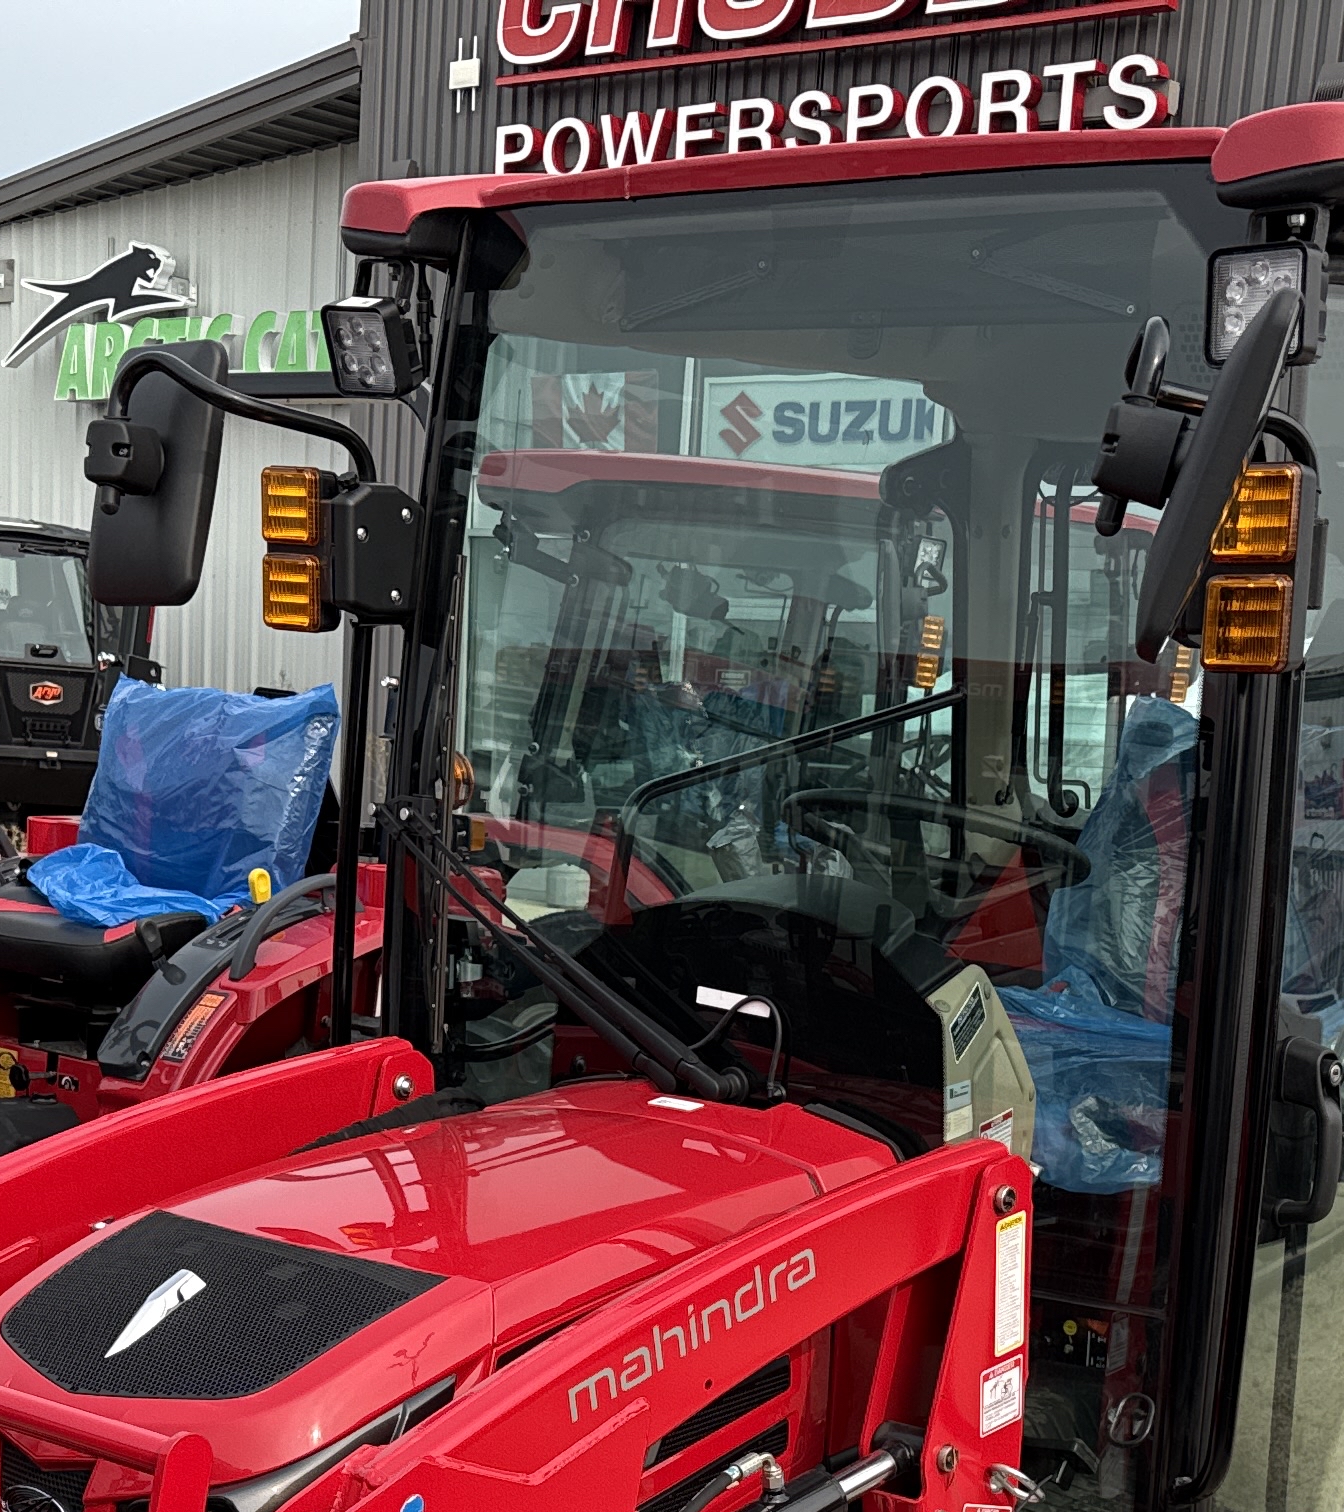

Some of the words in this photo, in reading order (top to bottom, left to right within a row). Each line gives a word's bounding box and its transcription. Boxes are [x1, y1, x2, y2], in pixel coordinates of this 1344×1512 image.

[494, 54, 1169, 174] POWERSPORTS
[771, 398, 936, 445] SUZUK
[567, 1247, 818, 1424] mahindra
